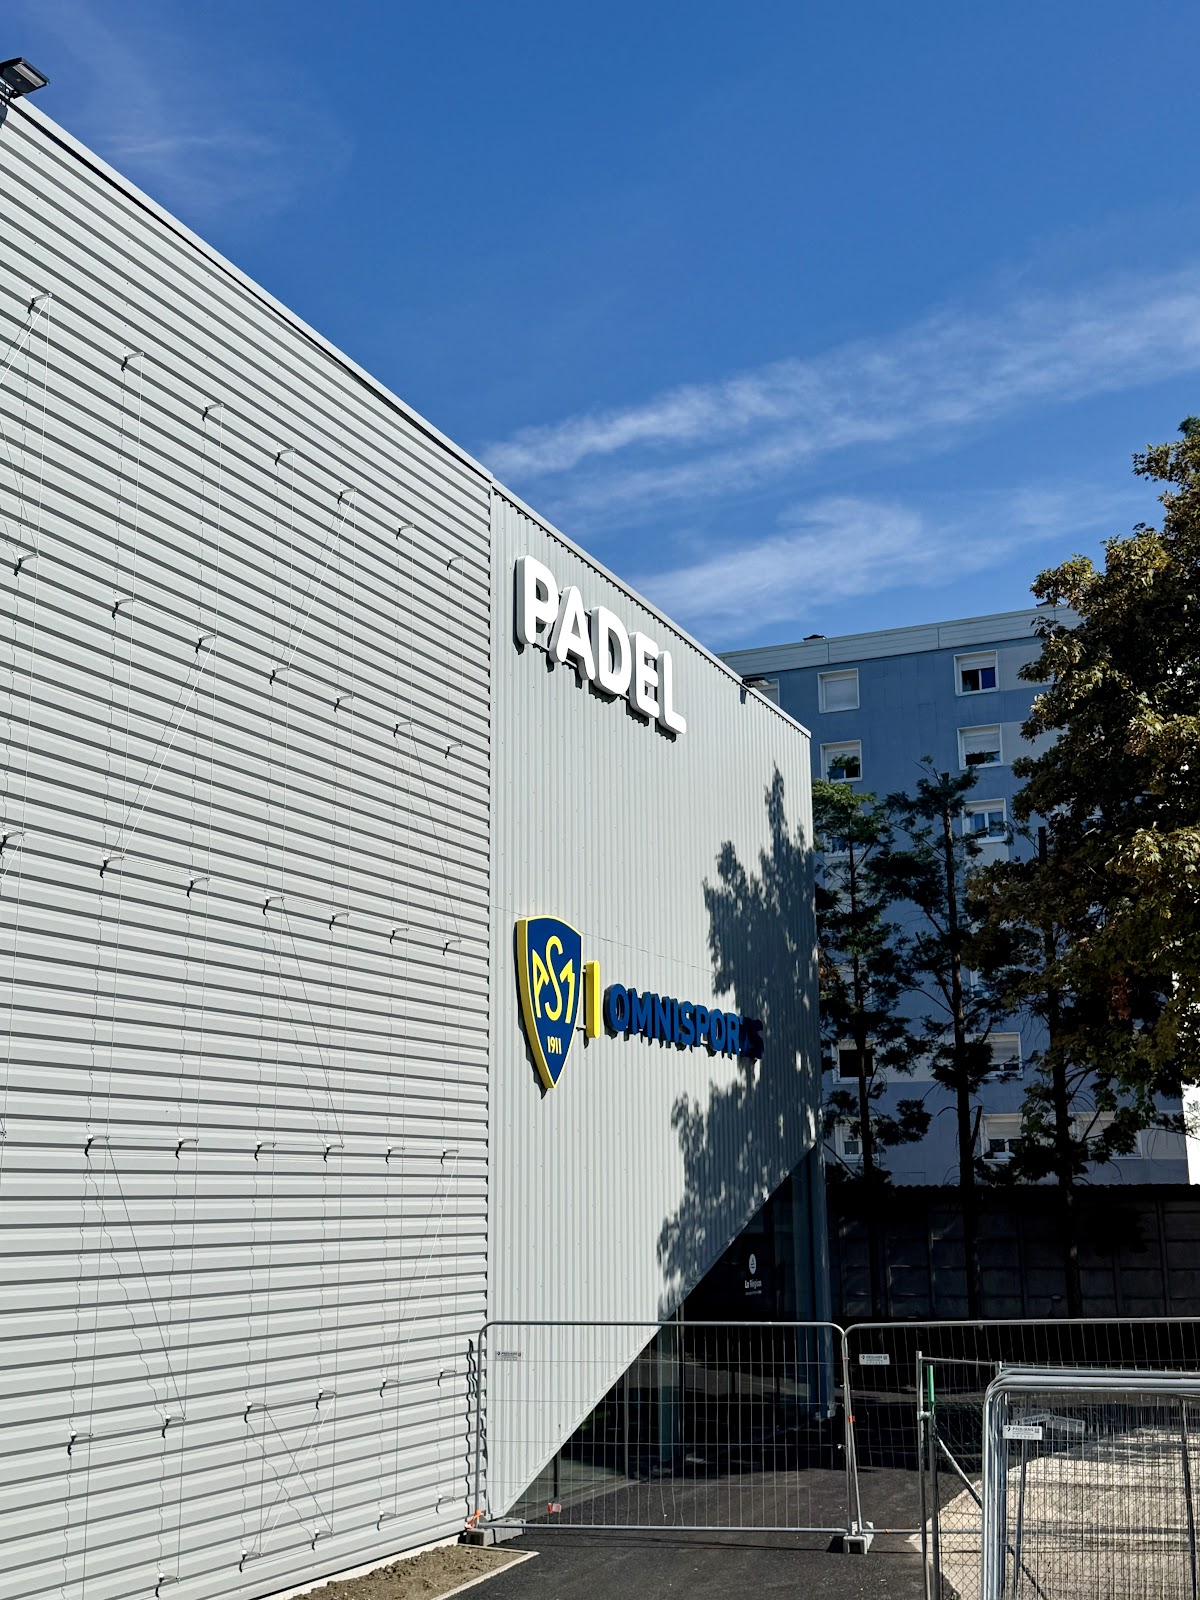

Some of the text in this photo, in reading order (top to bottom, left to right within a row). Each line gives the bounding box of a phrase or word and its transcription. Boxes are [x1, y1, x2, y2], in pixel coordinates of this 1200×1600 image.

[516, 555, 687, 735] PADEL
[532, 935, 576, 1024] ASM
[547, 1035, 562, 1055] 1911
[603, 983, 765, 1060] OMNISPORTS
